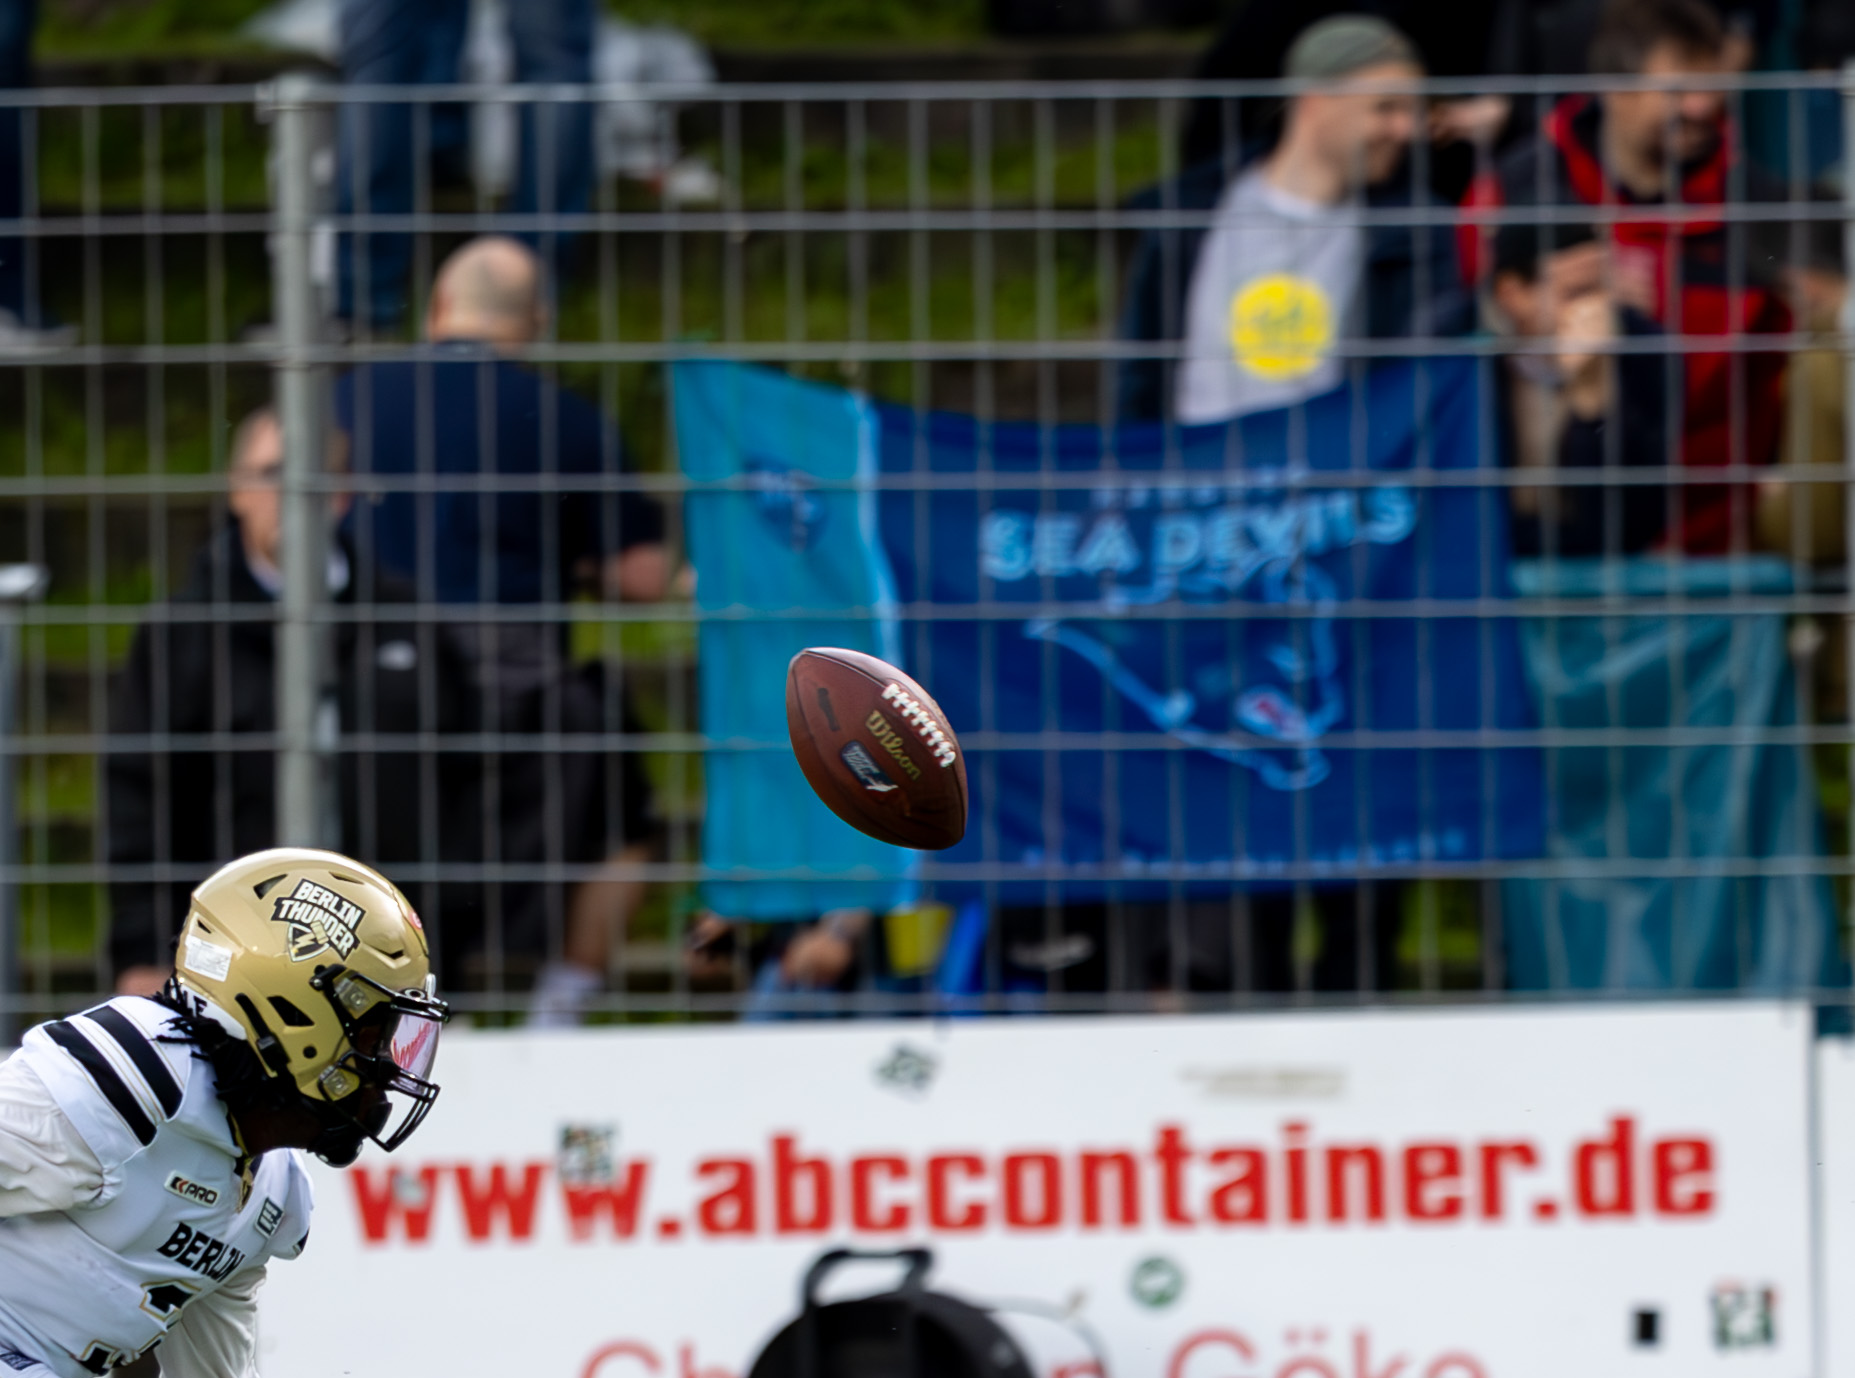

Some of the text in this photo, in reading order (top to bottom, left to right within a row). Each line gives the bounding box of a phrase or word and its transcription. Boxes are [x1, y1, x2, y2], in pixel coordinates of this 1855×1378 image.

[980, 509, 1140, 581] SEA
[865, 710, 921, 780] Wilson
[278, 899, 355, 957] THUNDER
[293, 881, 362, 930] BERLIN
[350, 1112, 1718, 1246] www.abccontainer.de
[157, 1221, 246, 1284] BERLIN
